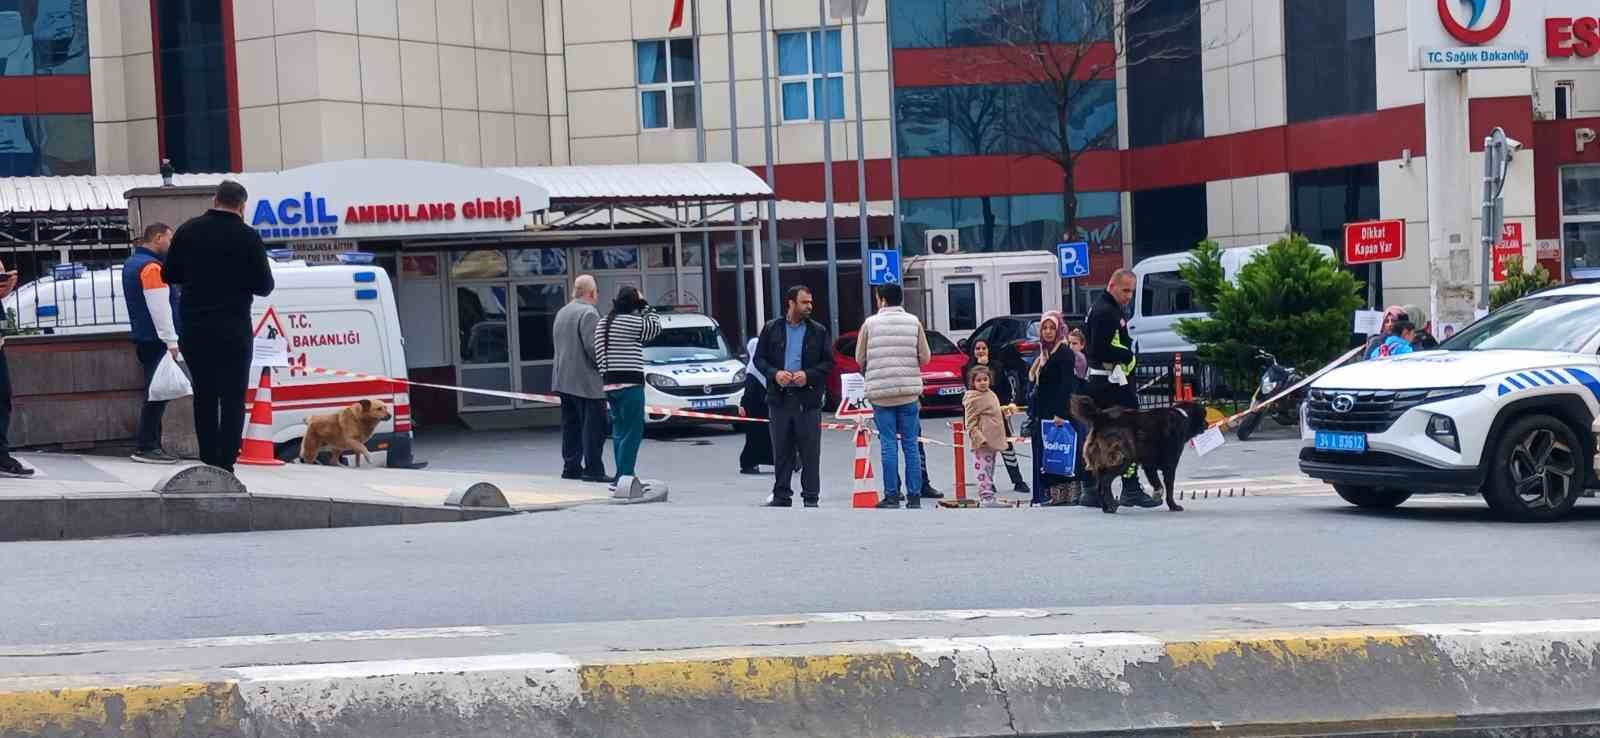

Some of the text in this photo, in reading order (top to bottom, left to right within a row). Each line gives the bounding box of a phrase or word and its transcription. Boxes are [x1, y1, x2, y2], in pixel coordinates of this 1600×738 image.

[1545, 16, 1600, 59] ES
[1446, 51, 1477, 64] Sağlık
[1481, 50, 1529, 63] Bakanlığı
[252, 191, 522, 225] ACİL AMBULANS GİRİŞİ
[259, 226, 338, 238] MERGENCY
[1361, 225, 1386, 240] Dikkat
[871, 252, 888, 280] P
[1060, 247, 1077, 275] P
[288, 314, 311, 329] T.C.
[293, 330, 360, 347] BAKANLIĞI
[1319, 433, 1329, 448] 34
